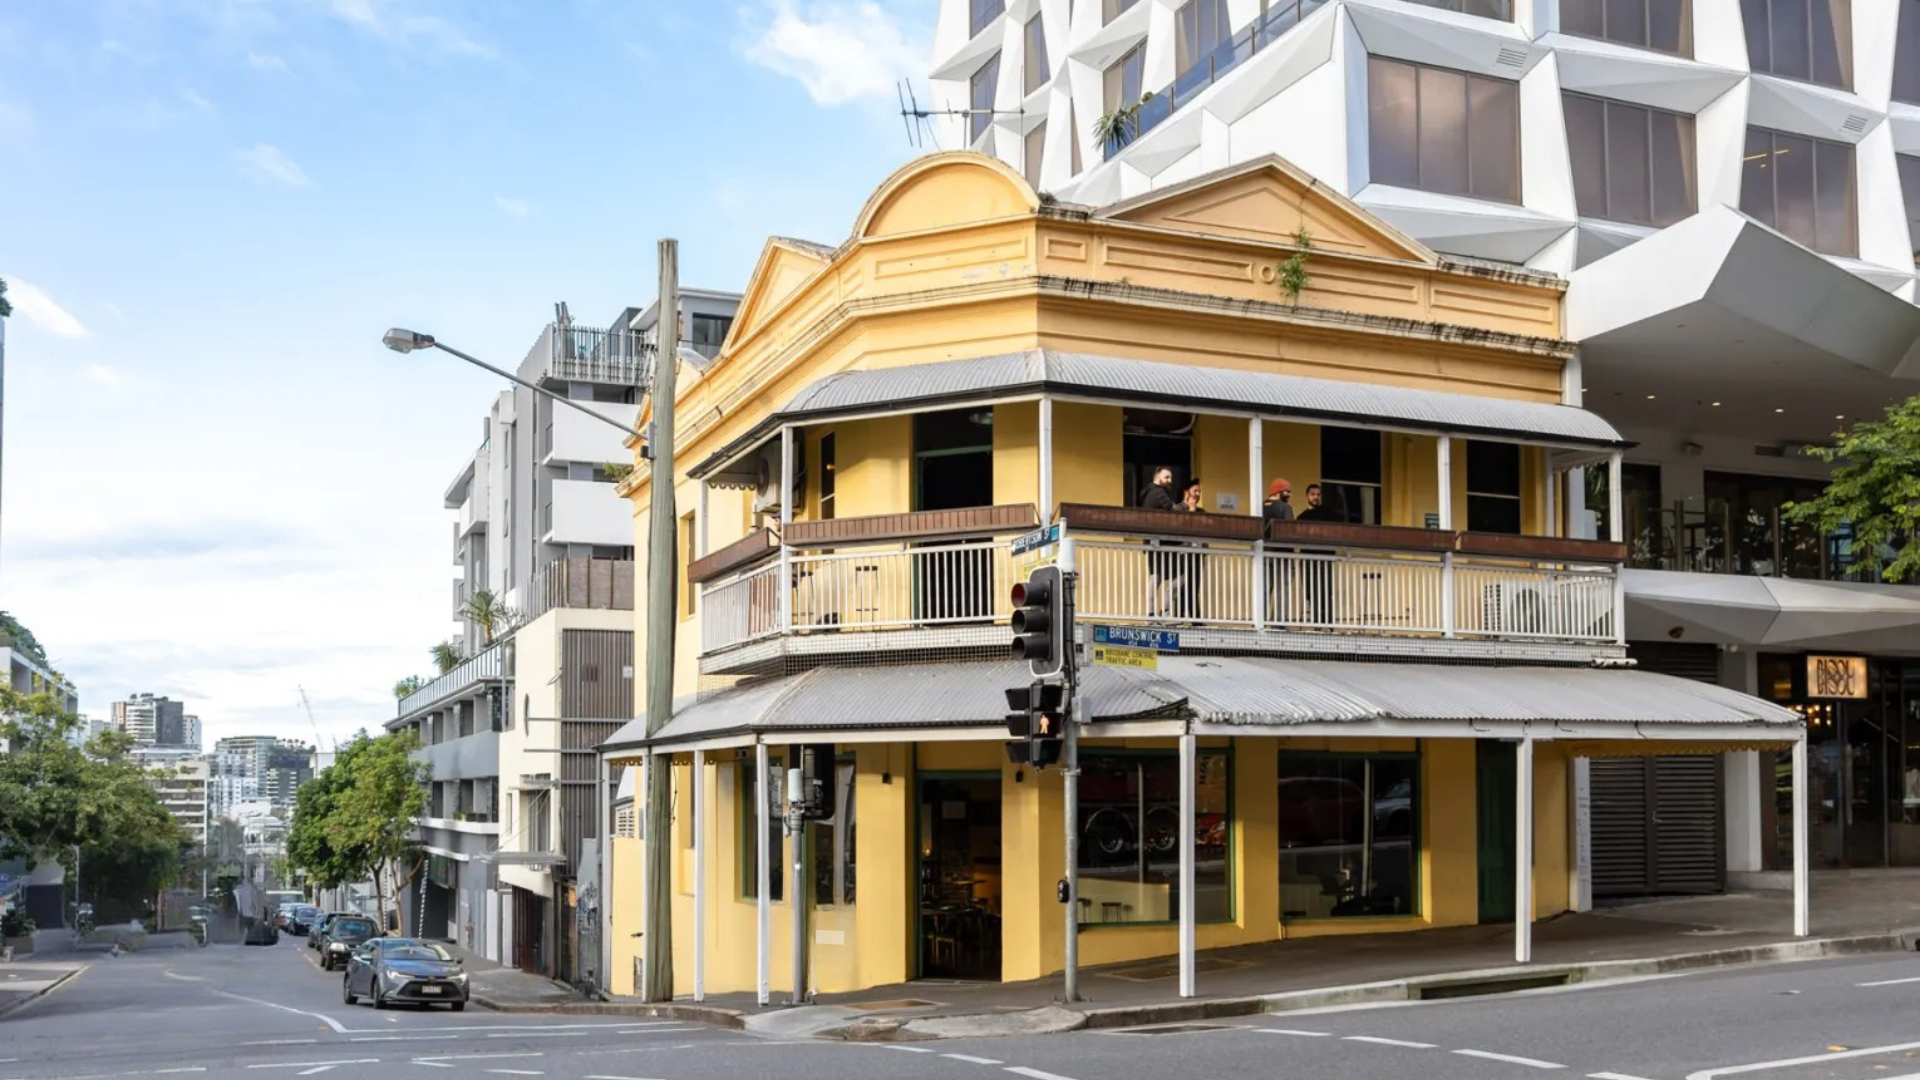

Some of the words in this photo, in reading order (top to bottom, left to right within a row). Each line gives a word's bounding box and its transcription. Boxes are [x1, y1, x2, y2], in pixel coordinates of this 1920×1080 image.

[1109, 627, 1161, 643] BRUNSWICK
[1167, 633, 1177, 645] ST
[1105, 648, 1131, 657] BRISBANE
[1105, 656, 1127, 665] TRAFFIC
[1128, 658, 1142, 666] AREA
